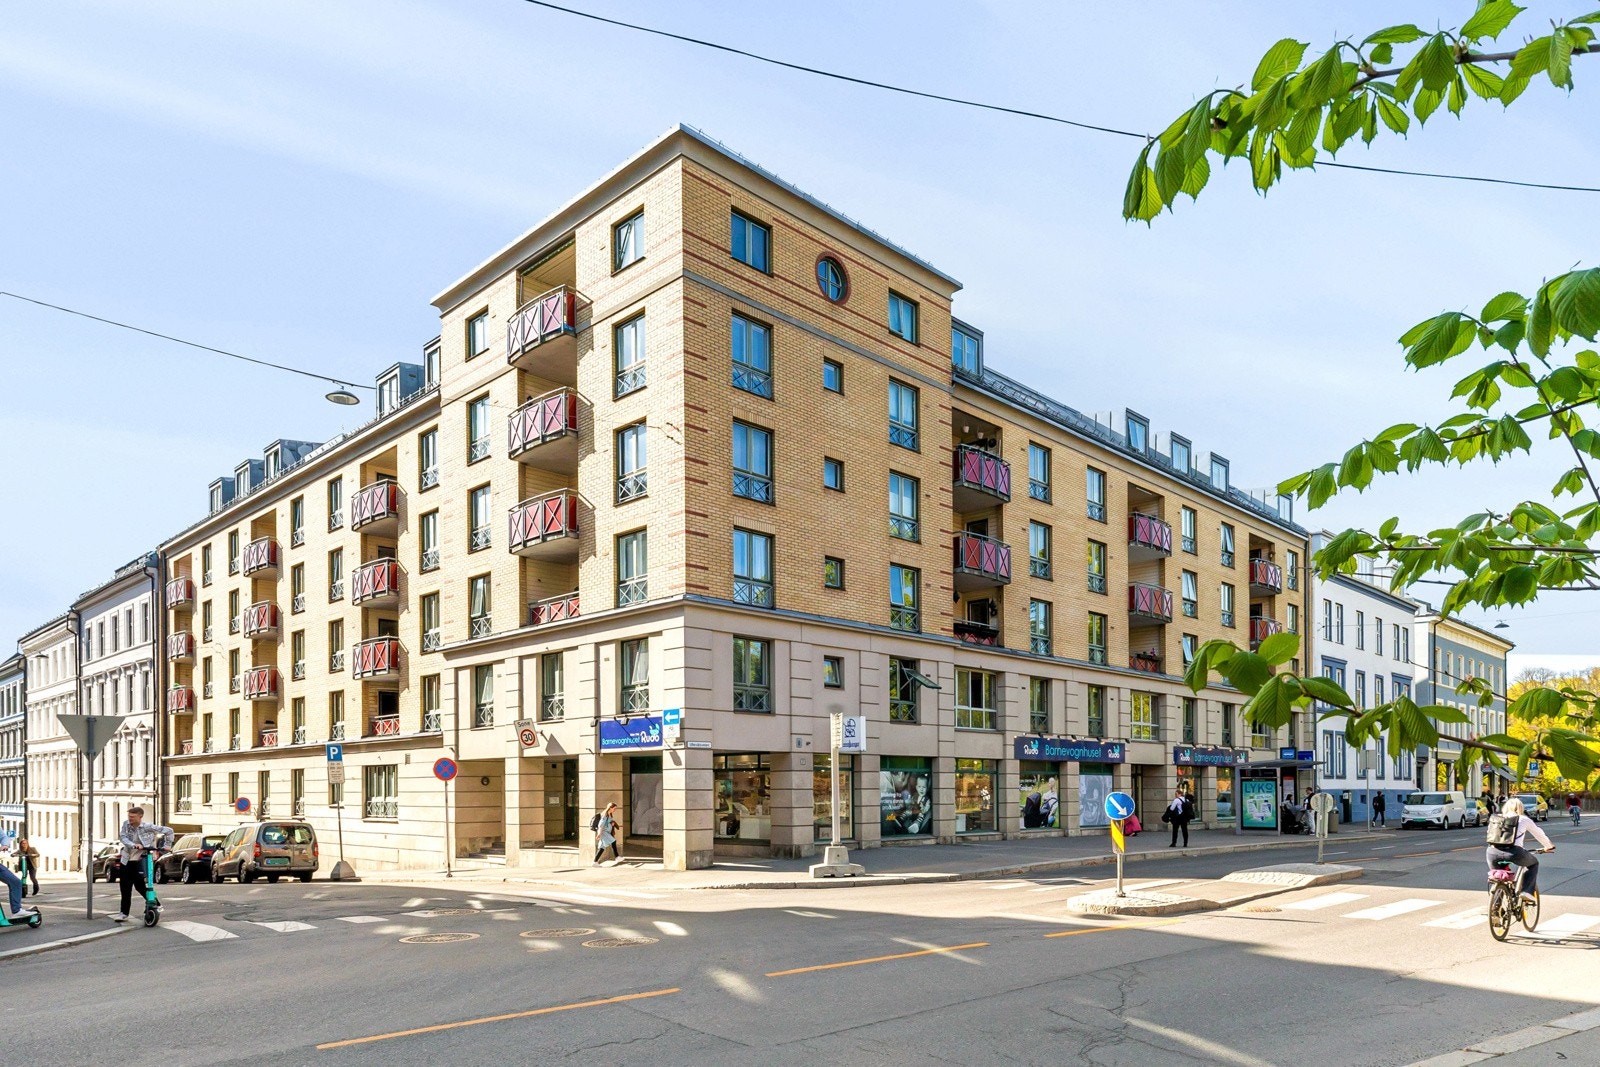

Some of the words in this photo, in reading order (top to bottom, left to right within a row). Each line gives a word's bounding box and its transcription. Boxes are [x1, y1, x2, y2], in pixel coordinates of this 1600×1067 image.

[523, 733, 533, 742] 30
[330, 746, 338, 760] P
[1045, 744, 1102, 759] Barnevognhuset
[1244, 783, 1273, 793] LYKO
